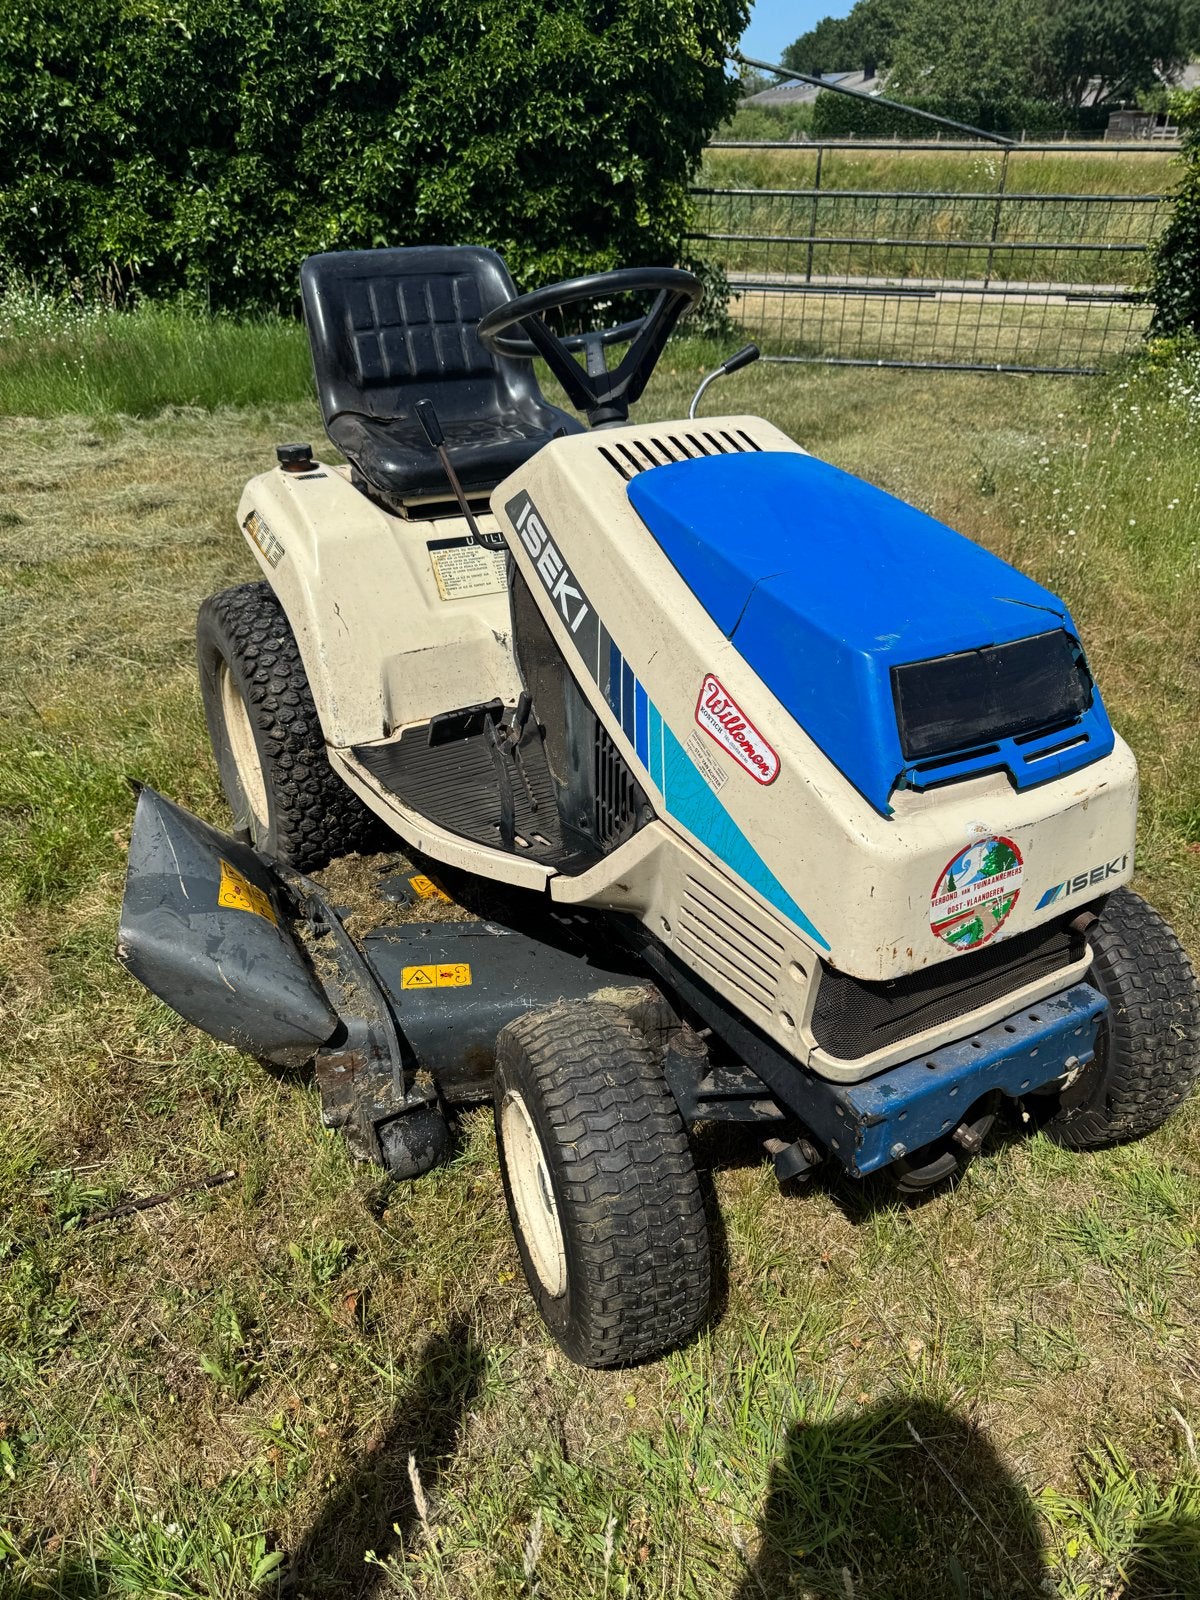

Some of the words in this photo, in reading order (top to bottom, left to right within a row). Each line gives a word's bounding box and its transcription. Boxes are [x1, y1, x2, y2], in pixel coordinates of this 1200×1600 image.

[516, 501, 589, 633] ISEKI
[706, 683, 770, 776] Willemen
[932, 891, 958, 908] VERBOND
[973, 866, 1023, 891] TUINAANNEMERS
[1066, 855, 1128, 896] ISEKI
